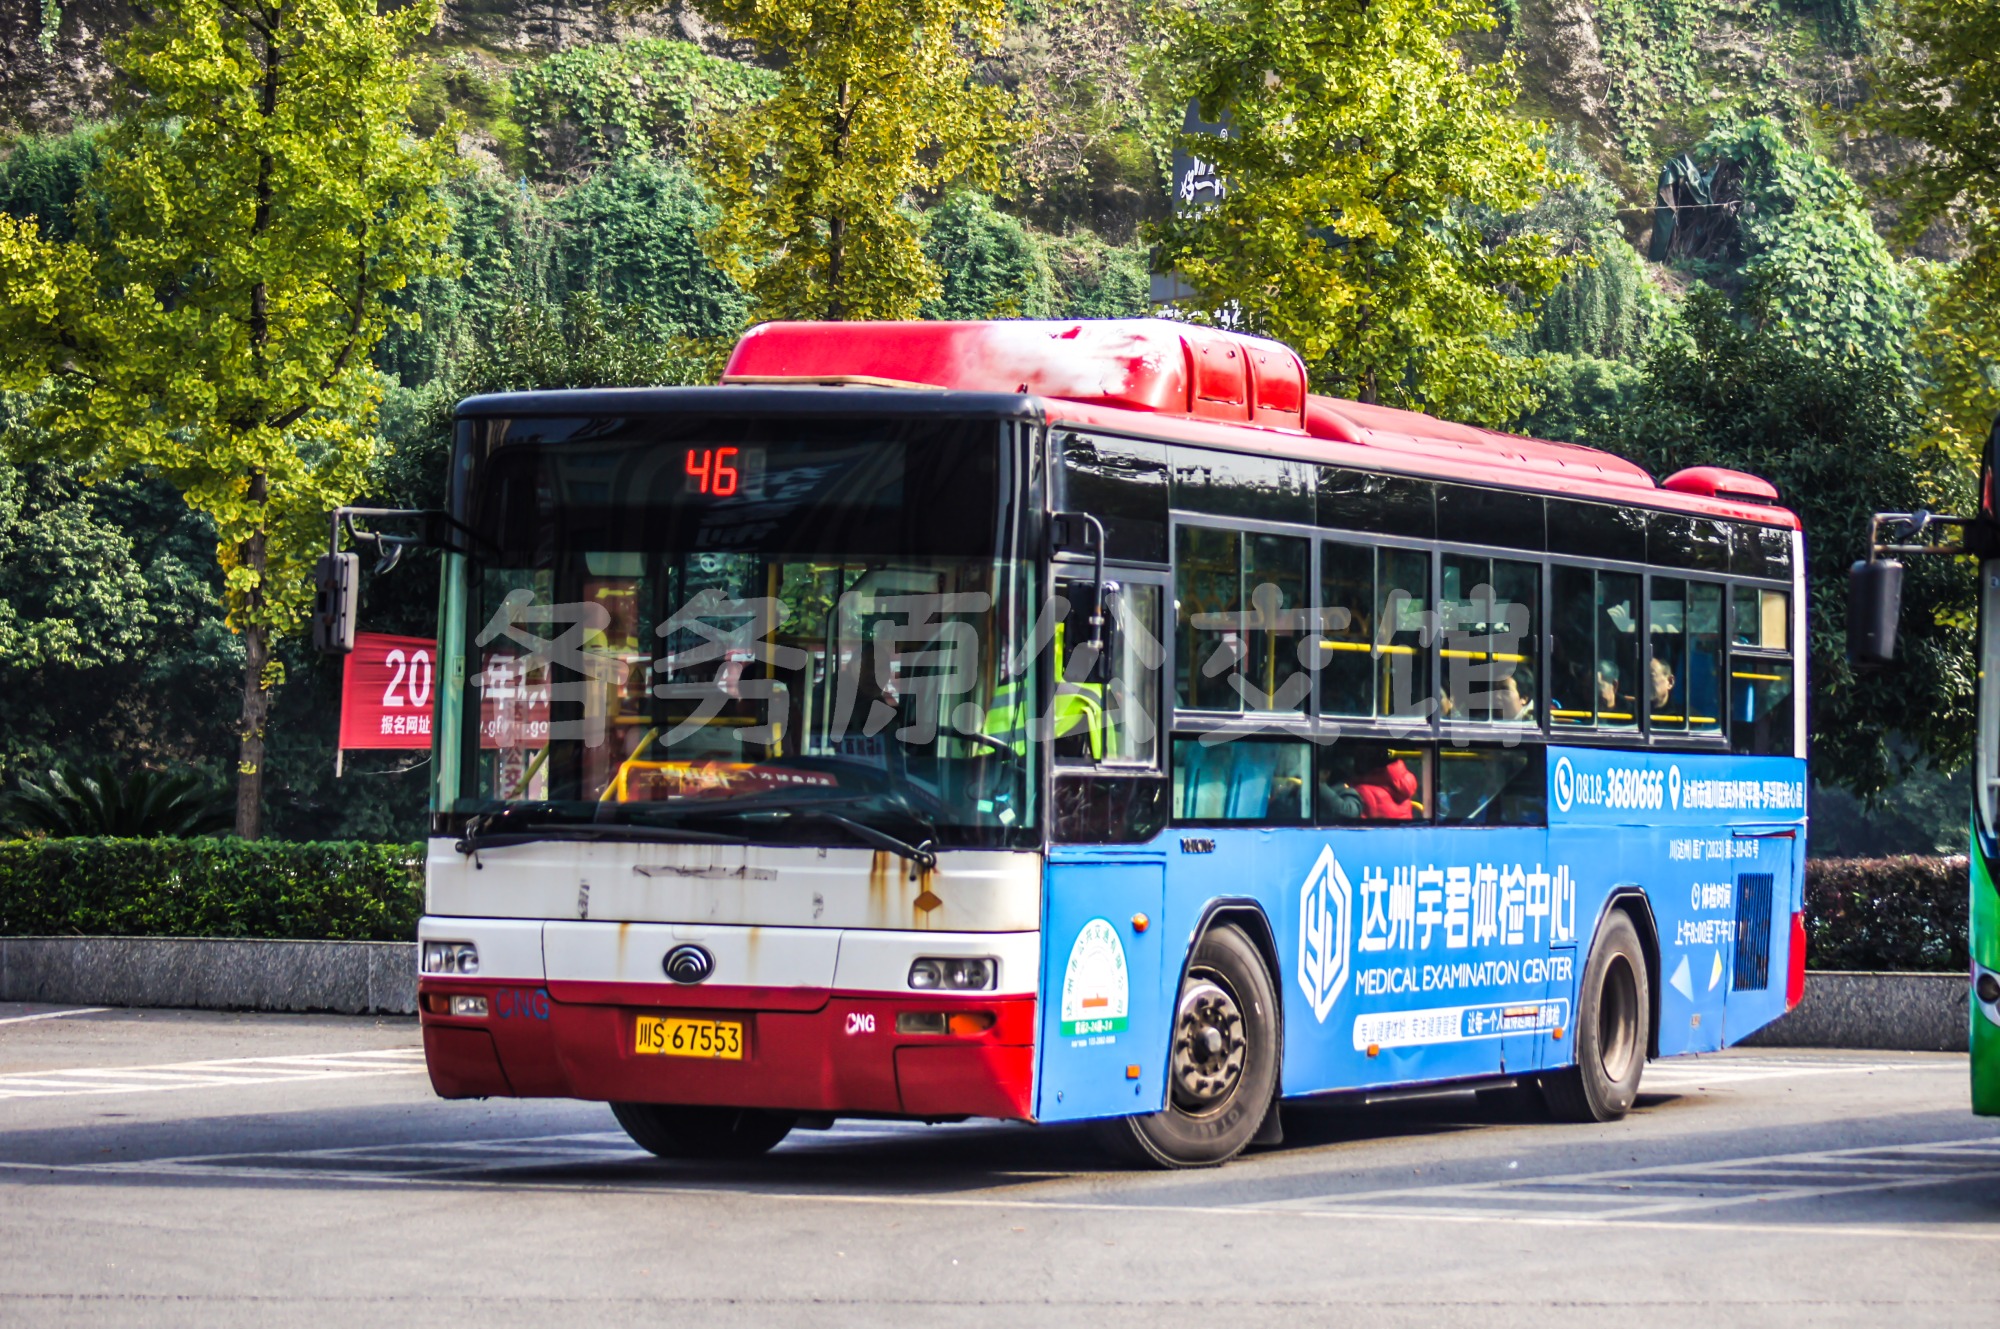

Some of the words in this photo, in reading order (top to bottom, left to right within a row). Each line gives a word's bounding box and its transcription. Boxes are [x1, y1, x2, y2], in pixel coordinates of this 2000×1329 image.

[686, 446, 738, 497] 46
[380, 715, 431, 735] 报名网址
[1576, 768, 1664, 809] 0818-3680666
[1358, 863, 1576, 952] 达州宇君体检中心
[1701, 882, 1732, 909] 体检时间
[1356, 967, 1420, 996] MEDICAL
[1422, 960, 1518, 991] EXAMINATION
[1522, 956, 1572, 984] CENTER
[495, 988, 549, 1020] CNG
[845, 1012, 876, 1035] CNG
